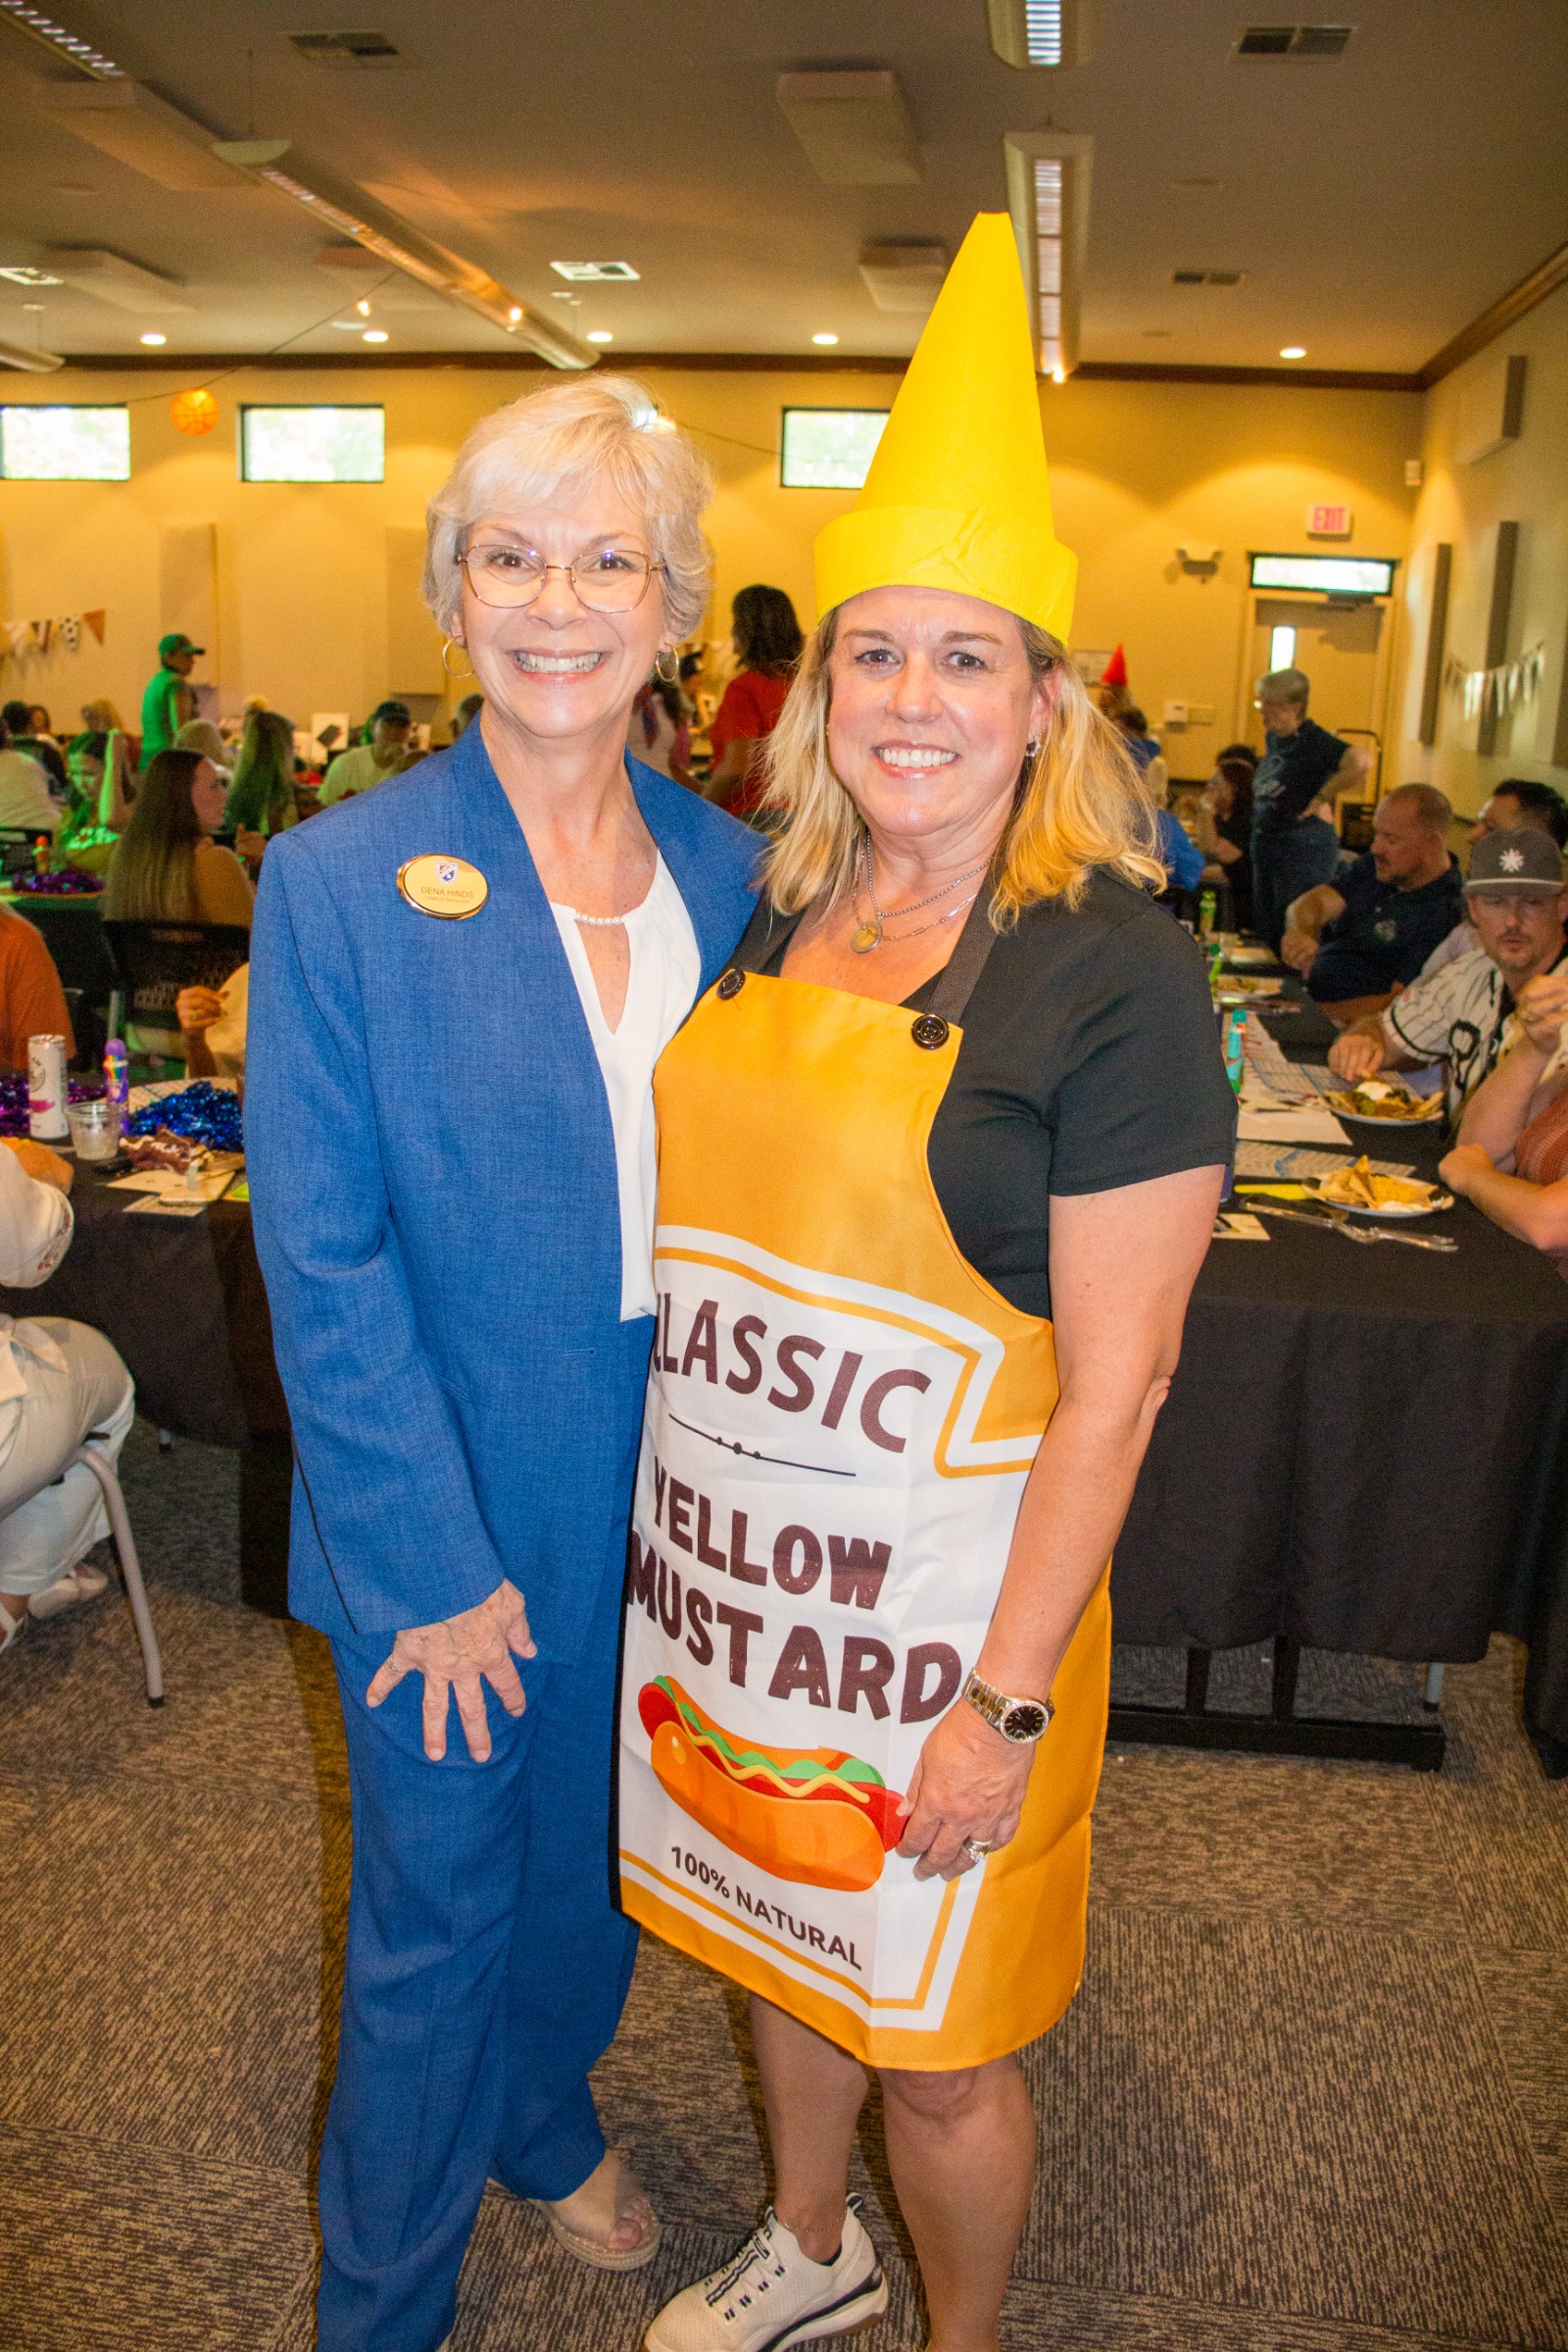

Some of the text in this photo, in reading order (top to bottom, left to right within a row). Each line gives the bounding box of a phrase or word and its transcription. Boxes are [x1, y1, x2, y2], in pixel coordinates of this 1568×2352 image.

[1313, 506, 1345, 531] EXIT
[420, 886, 474, 900] DENA HINDS
[654, 1454, 893, 1610] YELLOW
[626, 1530, 962, 1725] MUSTARD
[671, 1845, 863, 1972] 100% NATURAL
